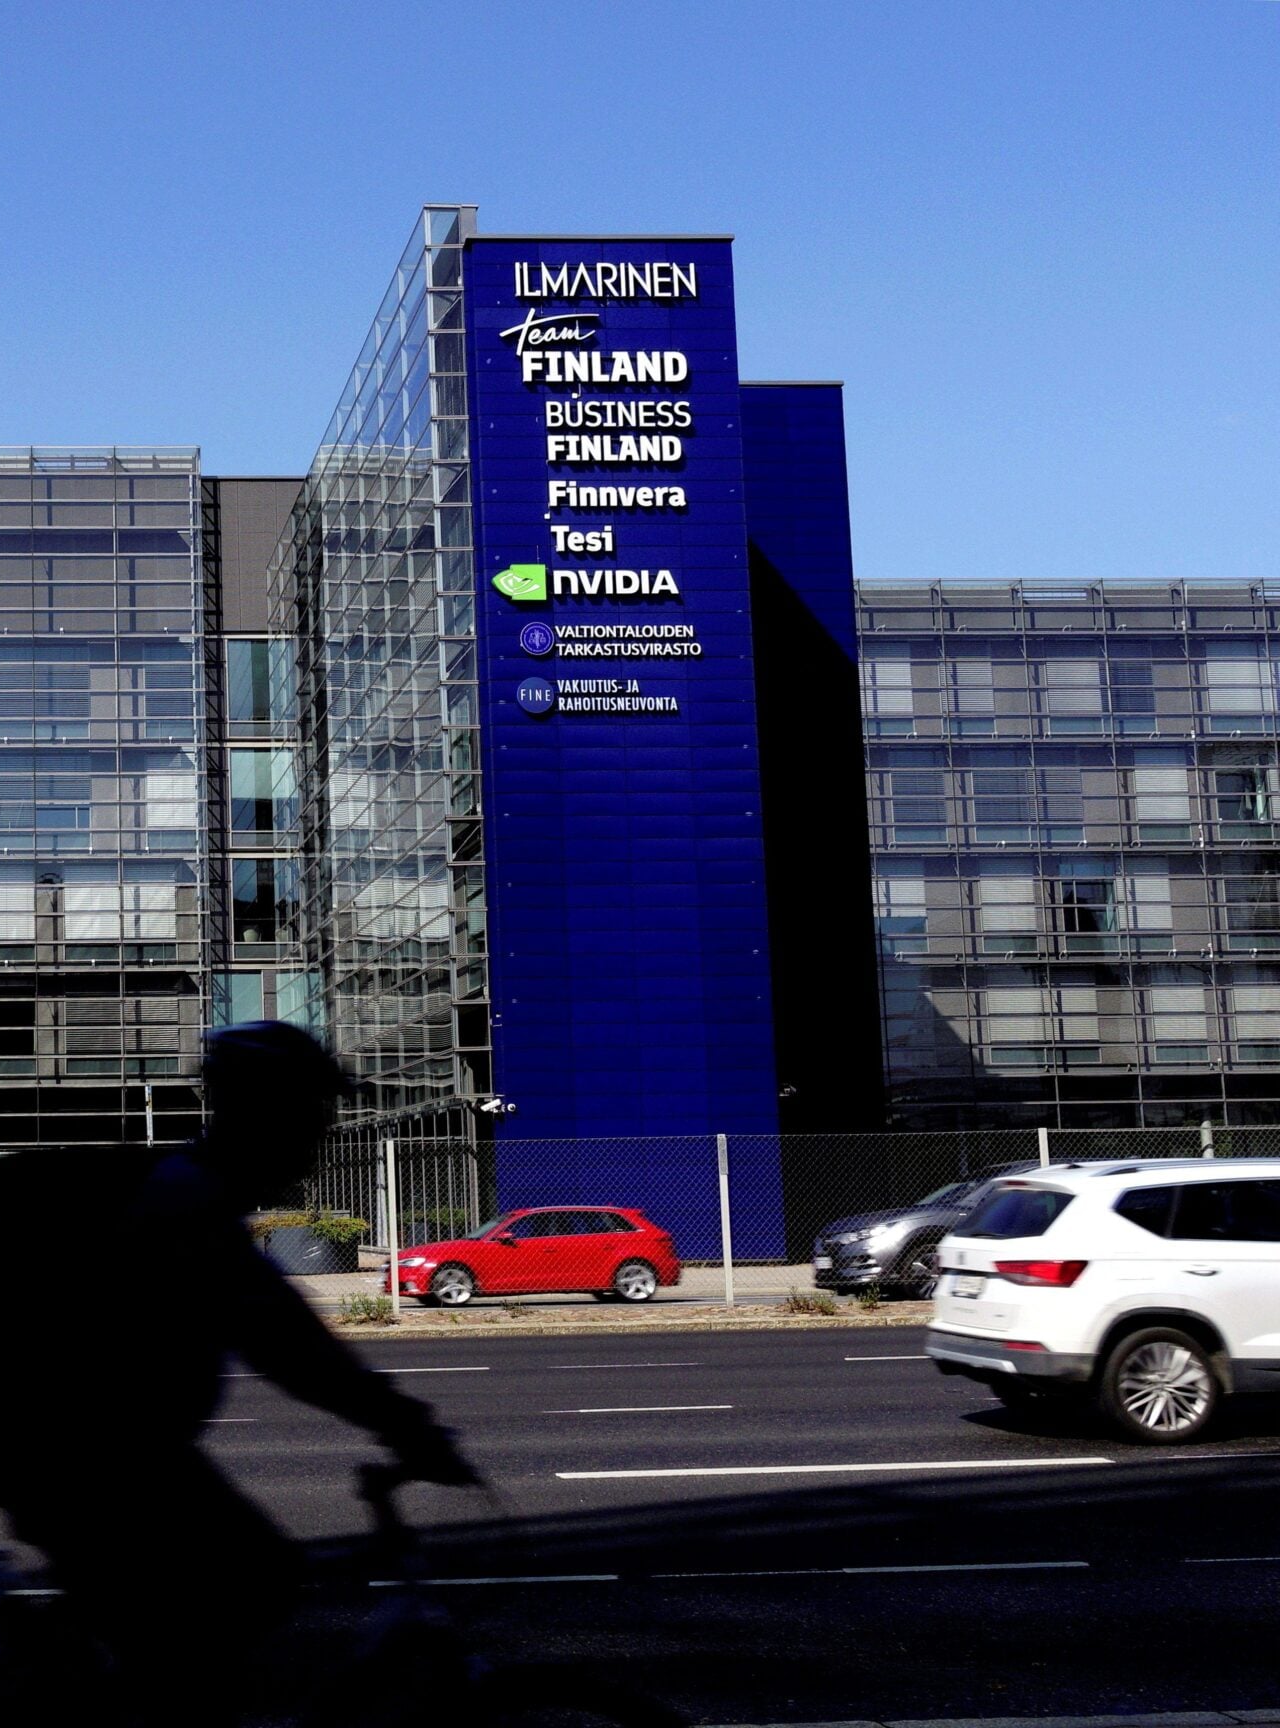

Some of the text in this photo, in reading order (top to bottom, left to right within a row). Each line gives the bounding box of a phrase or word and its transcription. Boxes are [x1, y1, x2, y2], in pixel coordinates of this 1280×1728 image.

[515, 262, 697, 298] ILMARINEN
[522, 351, 688, 383] FINLAND
[545, 401, 692, 427] BUSINESS
[547, 435, 682, 462] FINLAND
[548, 480, 687, 507] Finnvera
[550, 525, 613, 552] Tesi
[555, 625, 694, 638] VALTIONTALOUDEN
[556, 643, 702, 656] TARKASTUSVIRASTO
[520, 689, 551, 702] FINE
[557, 679, 640, 693] VAKUUTUS- JA
[558, 697, 678, 711] RAHOITUSNEUVONTA
